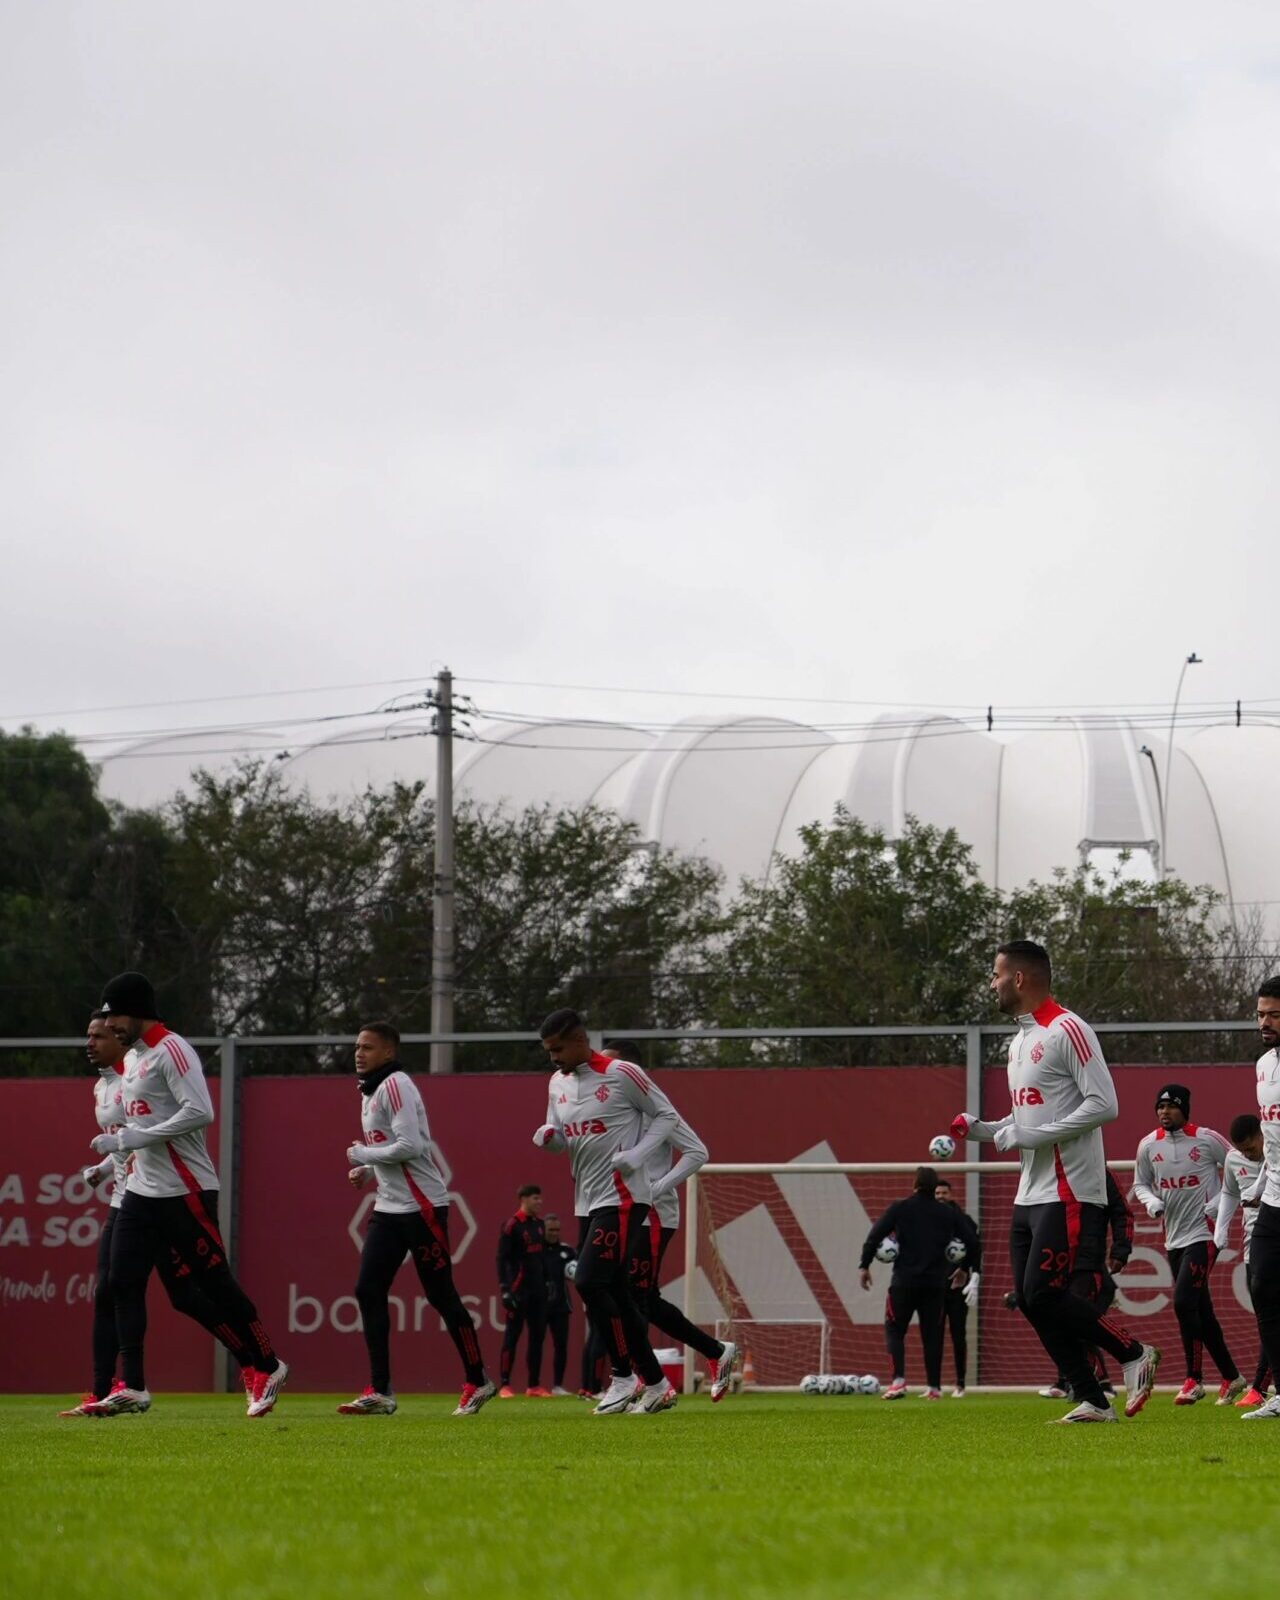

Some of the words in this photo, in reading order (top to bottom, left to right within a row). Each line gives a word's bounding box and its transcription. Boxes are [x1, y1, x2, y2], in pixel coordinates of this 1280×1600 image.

[1011, 1087, 1044, 1106] lfa
[125, 1099, 152, 1117] lfa
[42, 1207, 106, 1248] SÓ
[592, 1227, 618, 1248] 20
[1040, 1248, 1069, 1272] 29
